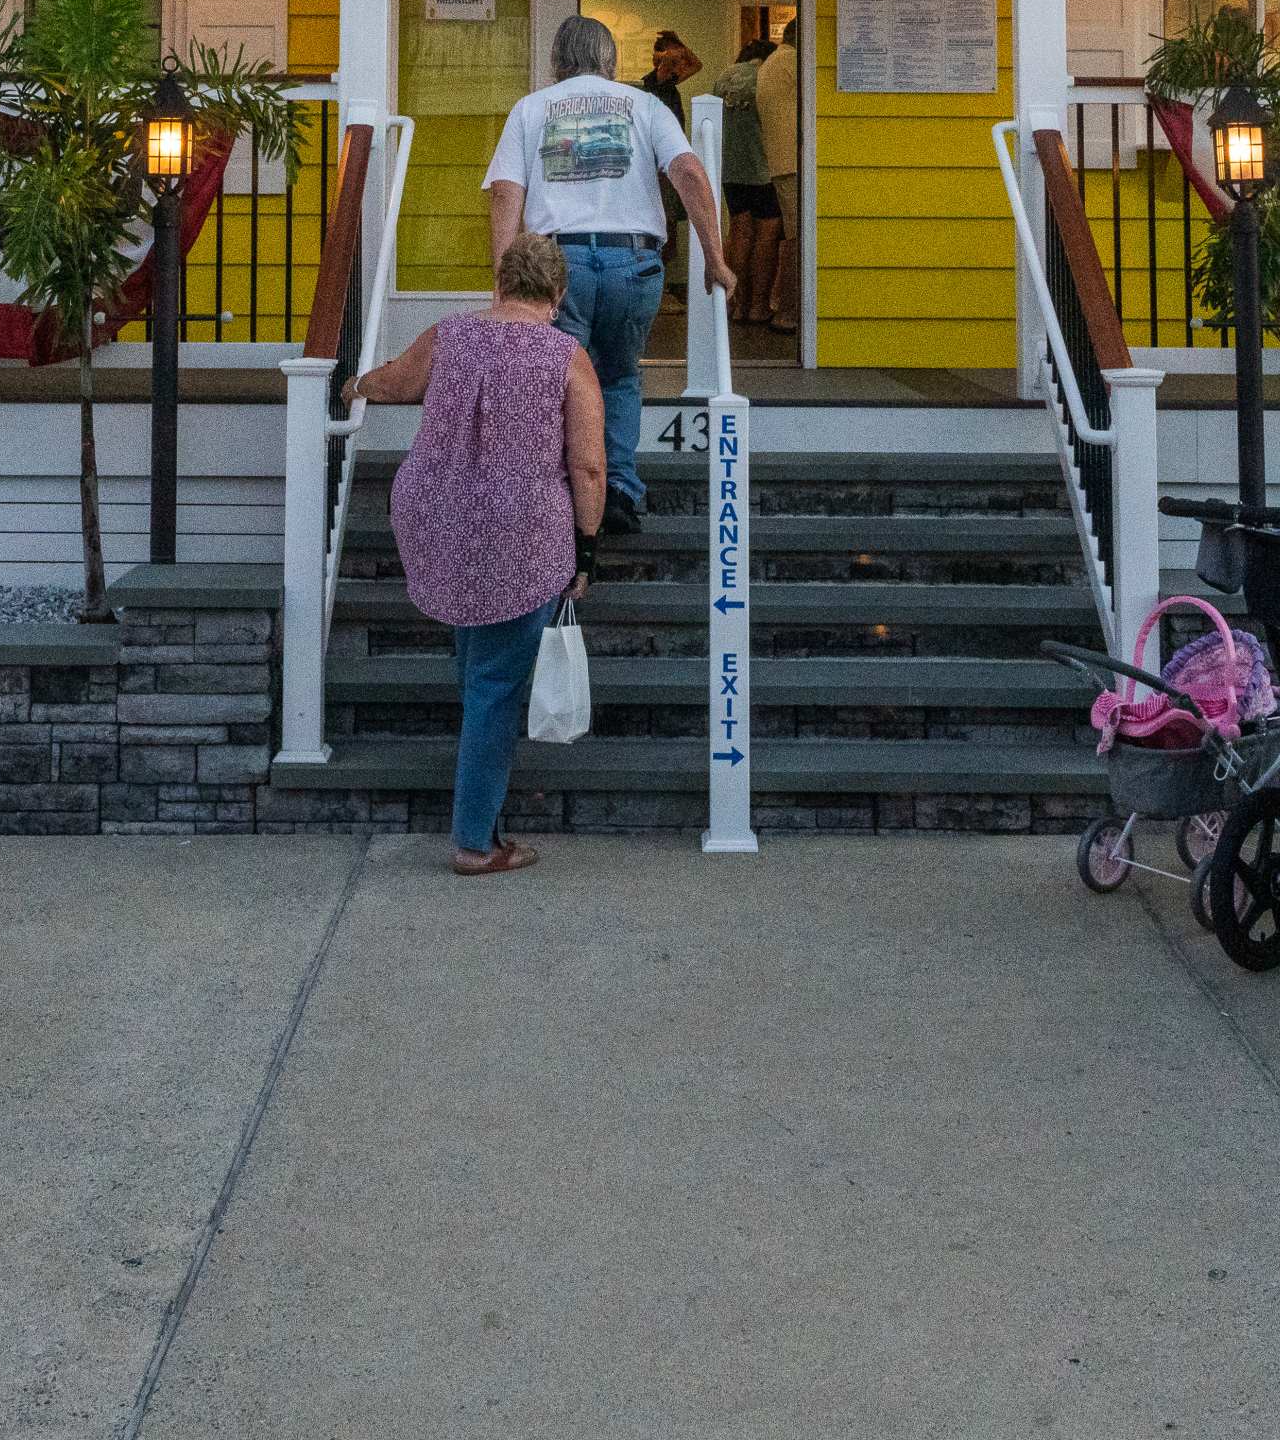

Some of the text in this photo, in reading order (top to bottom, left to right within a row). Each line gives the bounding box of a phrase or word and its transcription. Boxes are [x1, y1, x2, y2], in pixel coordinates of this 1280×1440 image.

[544, 95, 634, 126] AMERICAN MUSCLE
[719, 414, 739, 589] ENTRANCE
[720, 653, 739, 740] EXIT
